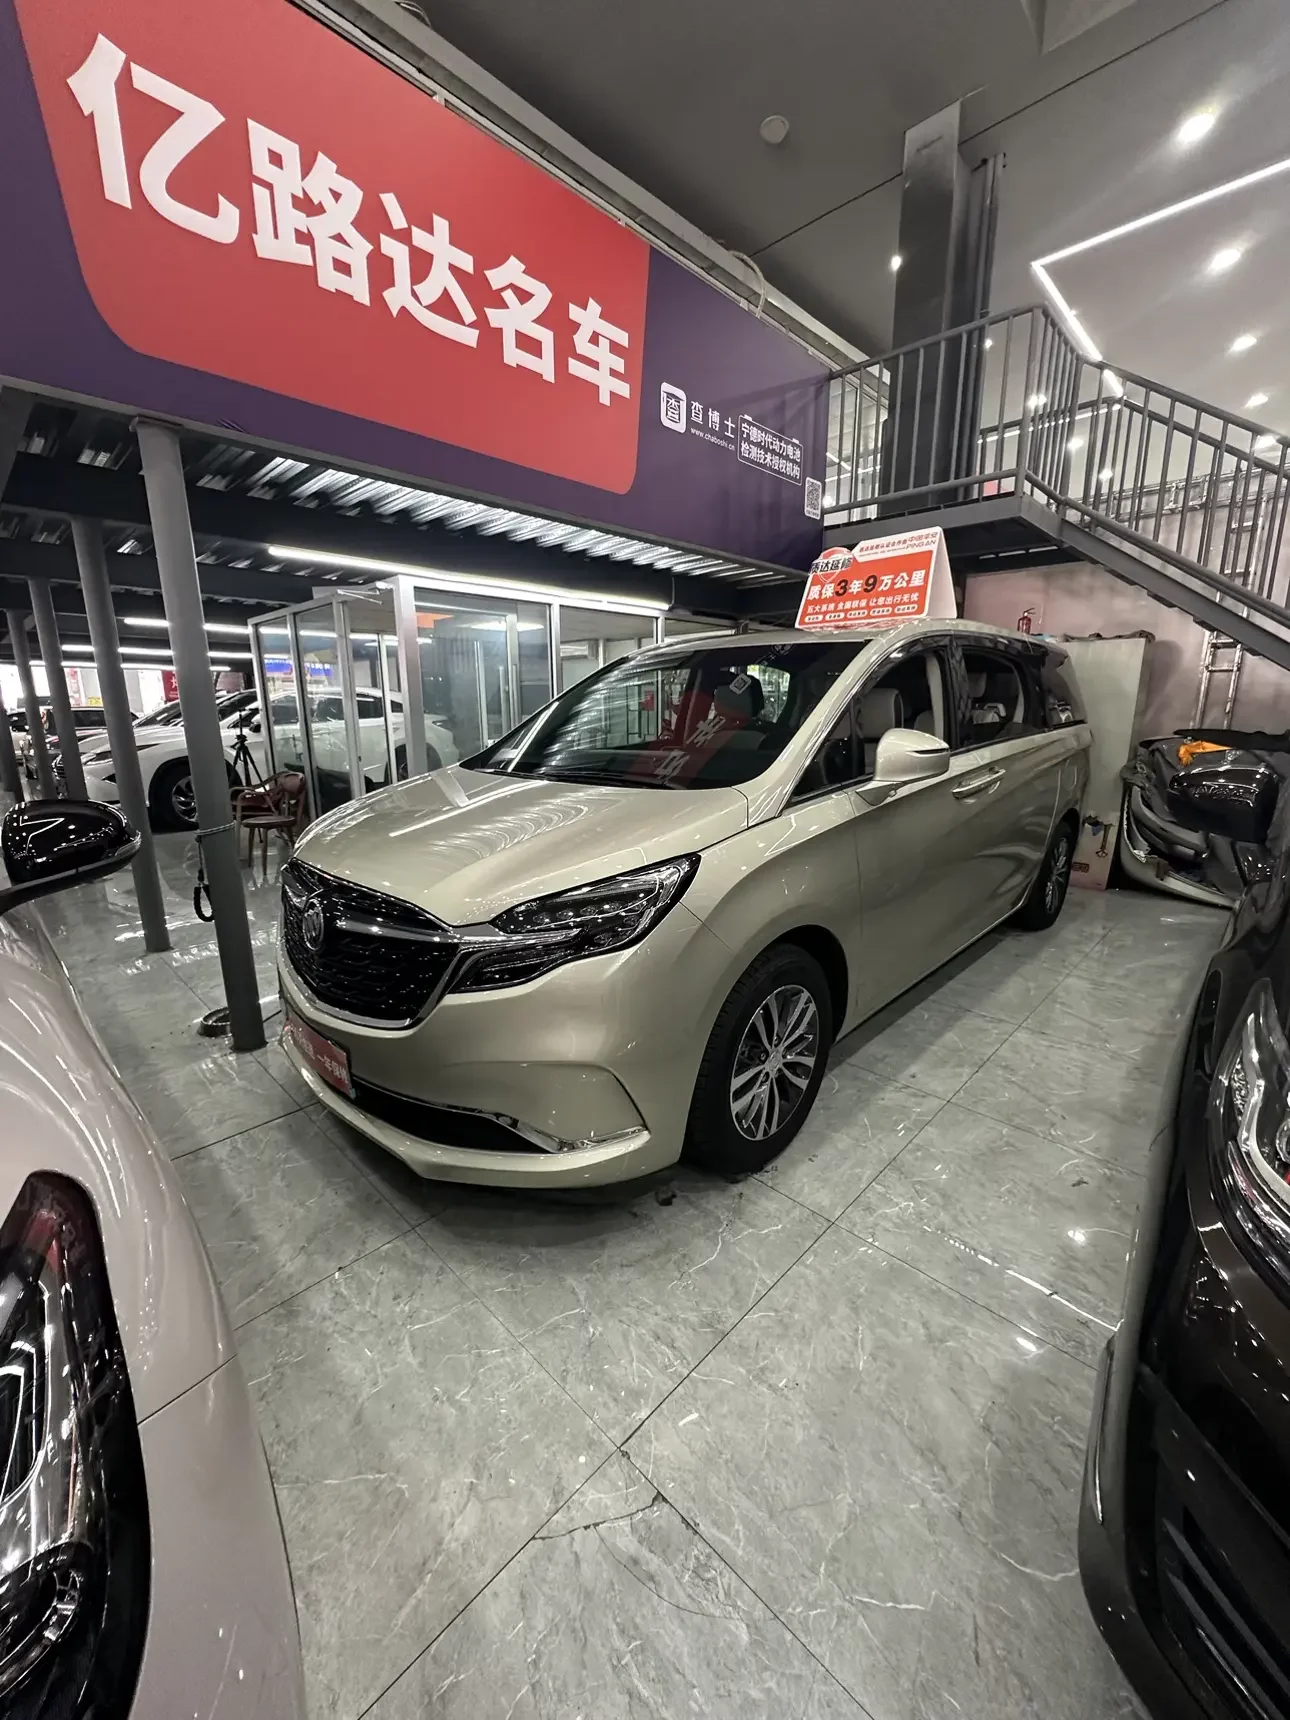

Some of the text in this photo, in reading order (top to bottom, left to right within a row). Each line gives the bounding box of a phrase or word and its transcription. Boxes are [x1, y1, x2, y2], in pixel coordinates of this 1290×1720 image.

[66, 33, 631, 407] 亿路达名车
[690, 400, 736, 439] 查博士
[690, 427, 736, 451] www.chaboshi.cn
[741, 421, 801, 462] 宁德时代动力电池
[740, 441, 801, 479] 检测技术授权机构
[807, 569, 926, 601] 质保3年9万公里
[869, 592, 920, 607] 让您出行无忧
